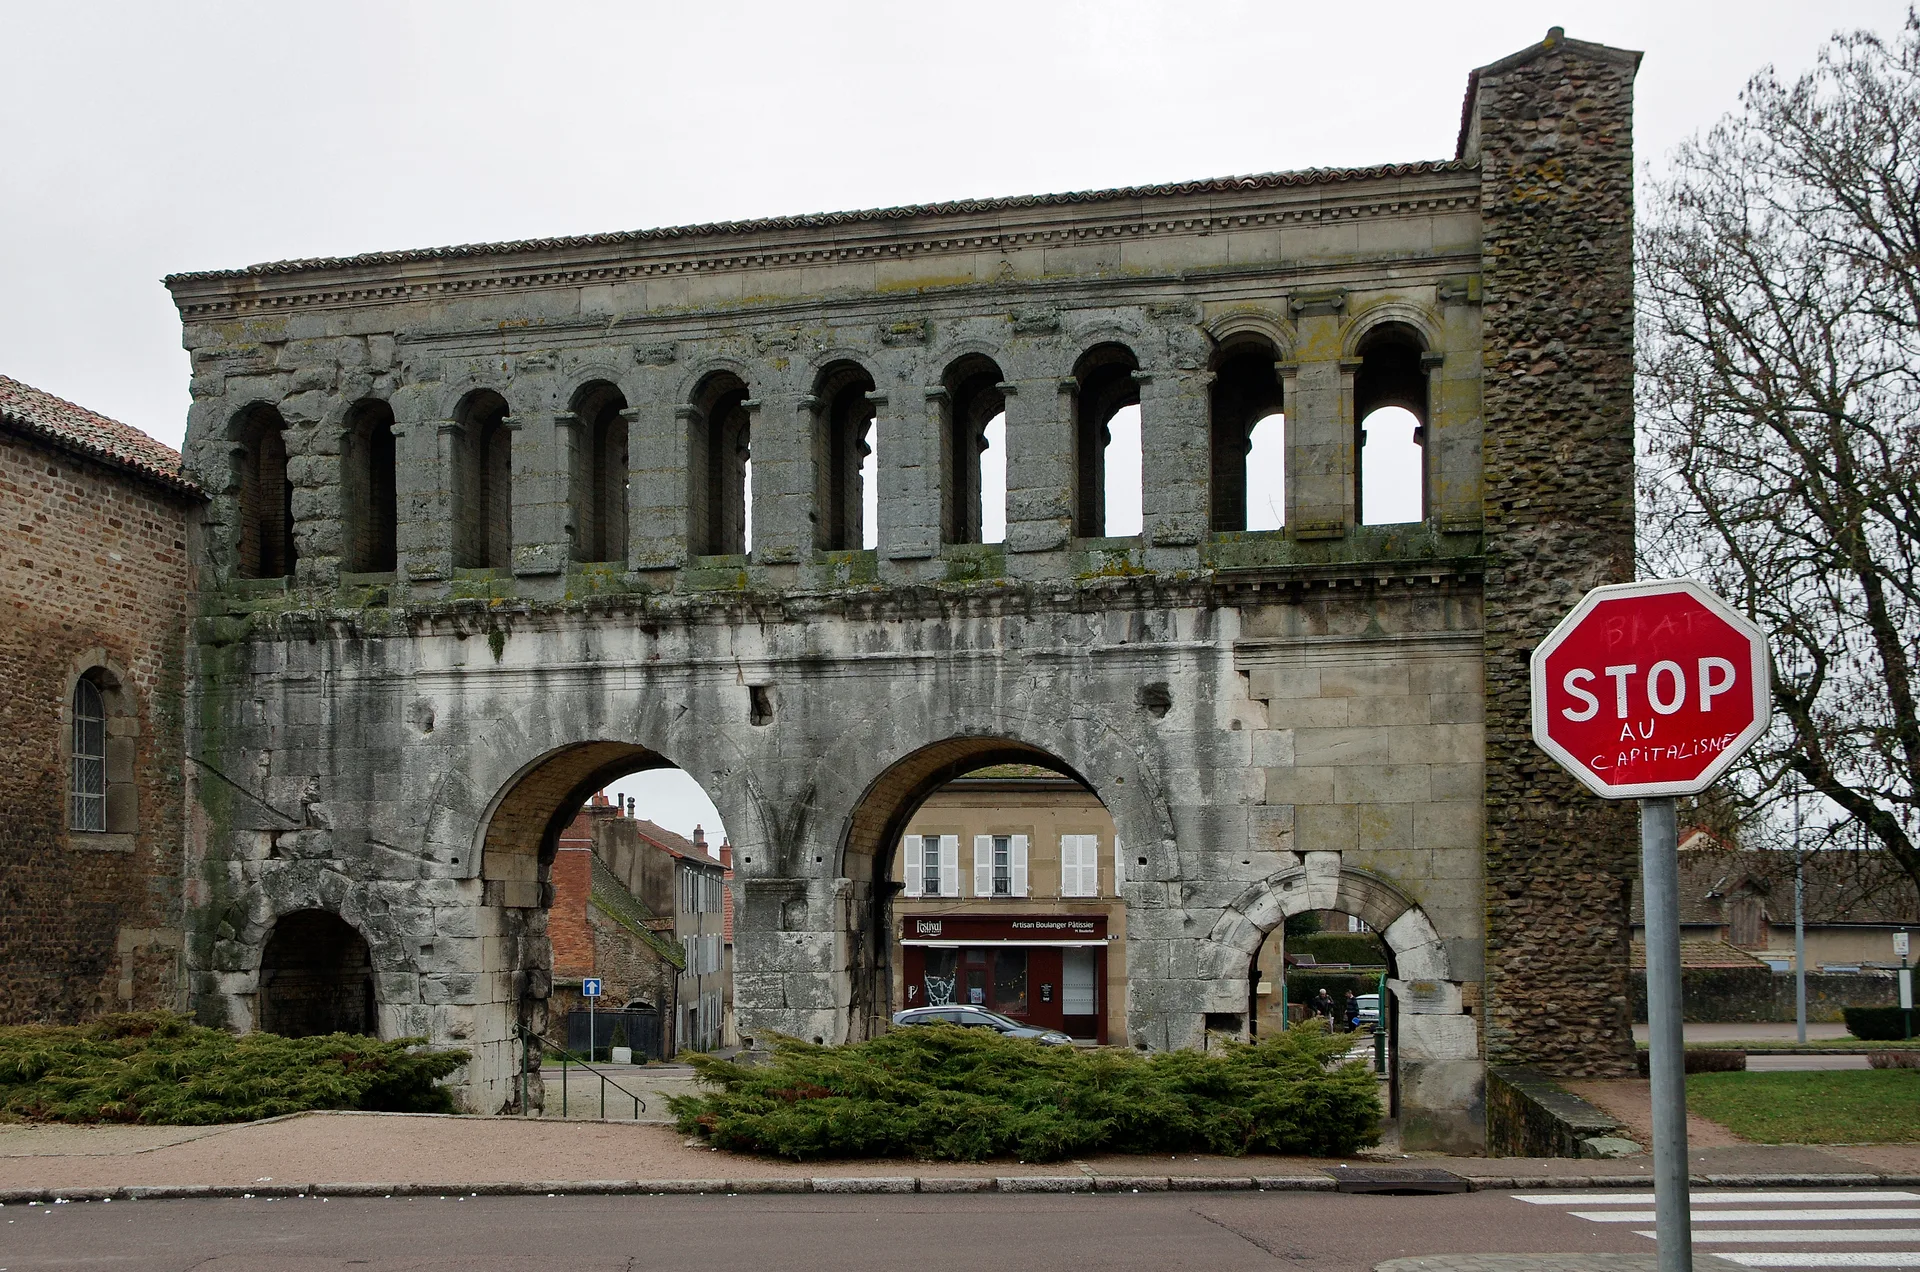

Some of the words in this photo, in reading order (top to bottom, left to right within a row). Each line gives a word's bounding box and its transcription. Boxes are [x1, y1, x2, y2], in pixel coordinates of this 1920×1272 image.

[1561, 657, 1736, 722] STOP
[1620, 718, 1654, 741] AU
[1036, 921, 1067, 930] Boulanger
